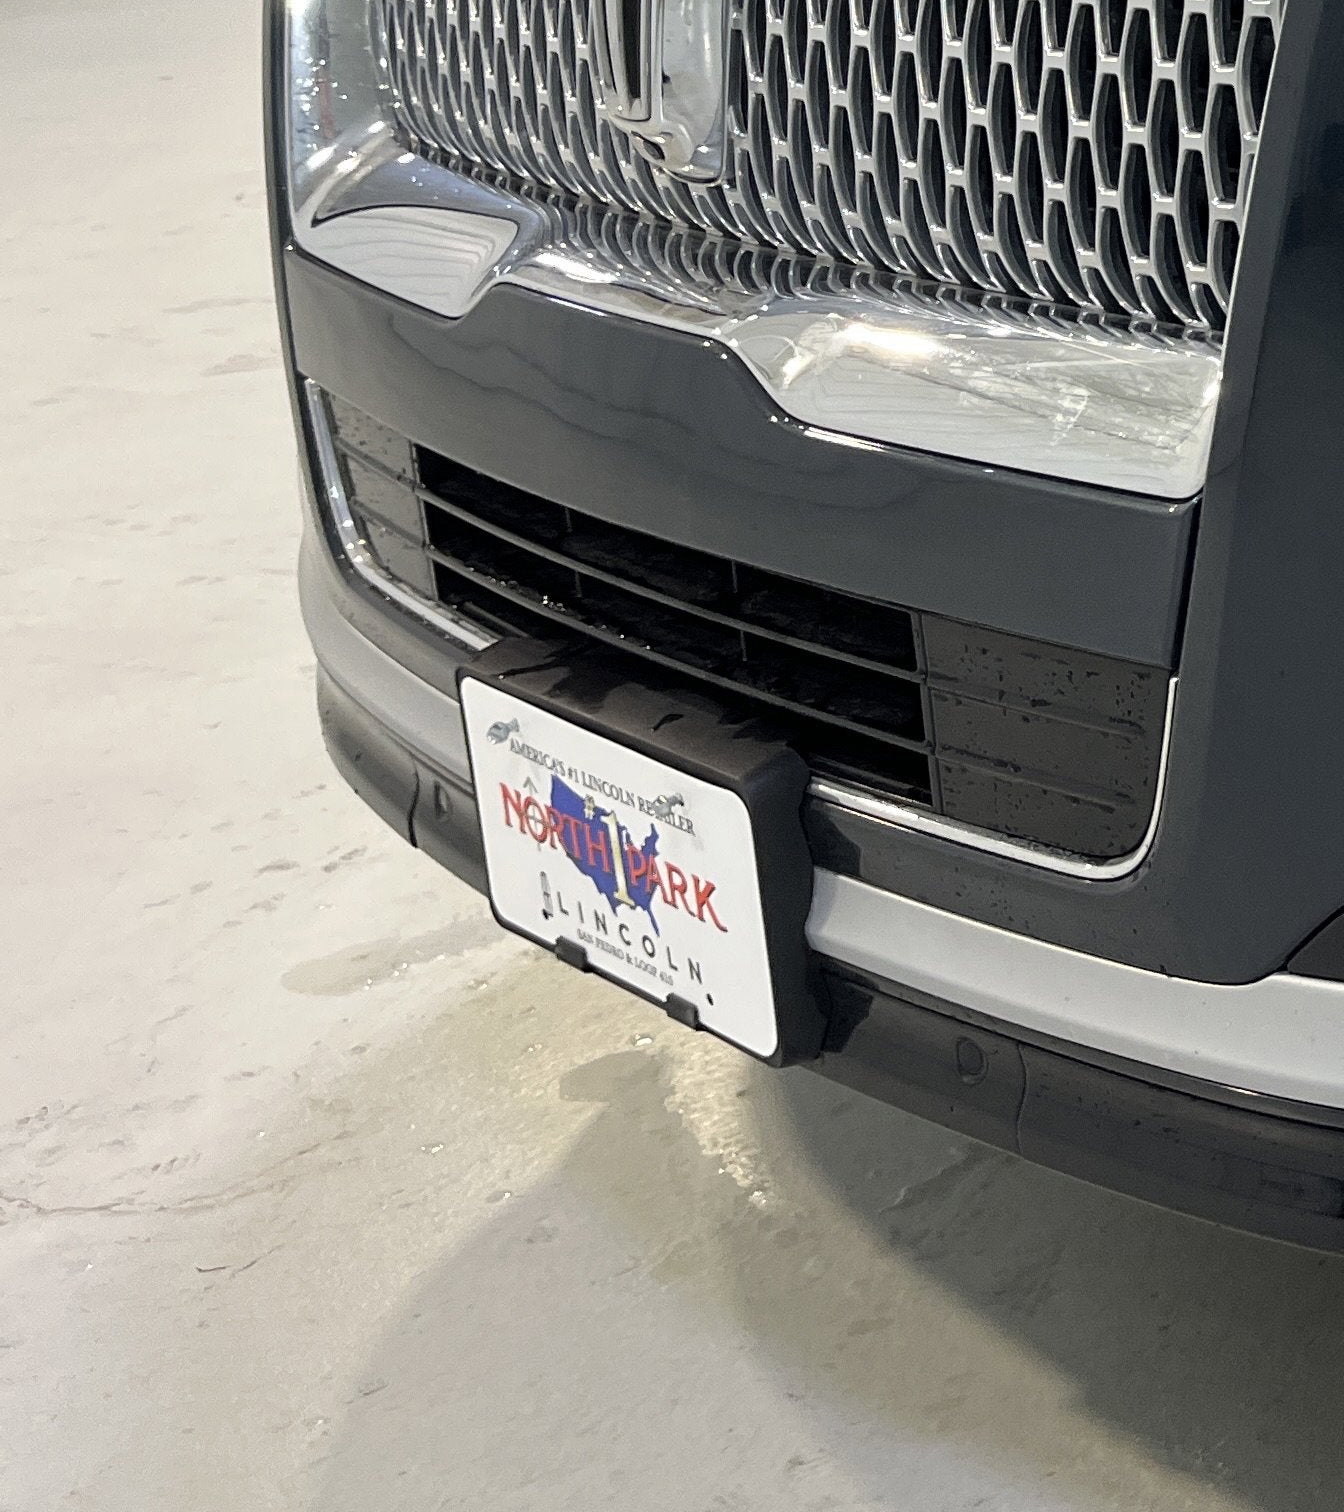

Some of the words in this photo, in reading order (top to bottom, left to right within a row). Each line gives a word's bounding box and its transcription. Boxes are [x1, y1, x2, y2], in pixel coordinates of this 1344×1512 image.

[510, 737, 567, 777] AMERICA'S
[580, 770, 636, 808] LINCOLN
[637, 795, 697, 838] REILER
[499, 782, 611, 874] NORTH
[624, 842, 728, 932] PARK
[556, 891, 703, 985] LINCOLN
